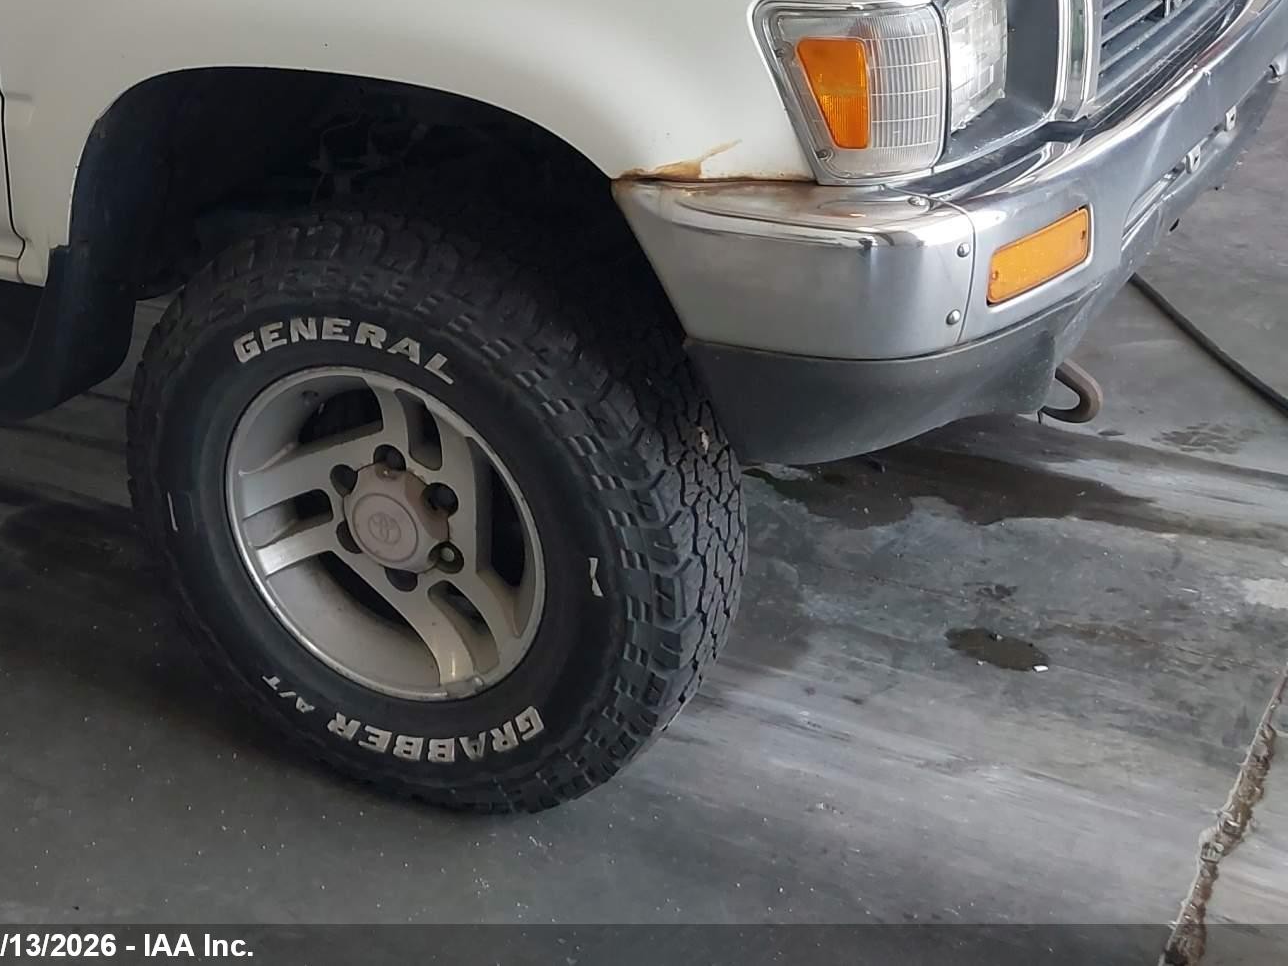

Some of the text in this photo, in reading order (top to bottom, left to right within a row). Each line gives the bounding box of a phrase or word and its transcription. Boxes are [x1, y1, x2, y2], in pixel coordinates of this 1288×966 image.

[233, 316, 454, 385] GENERAL
[262, 675, 544, 763] GRABBER A/T
